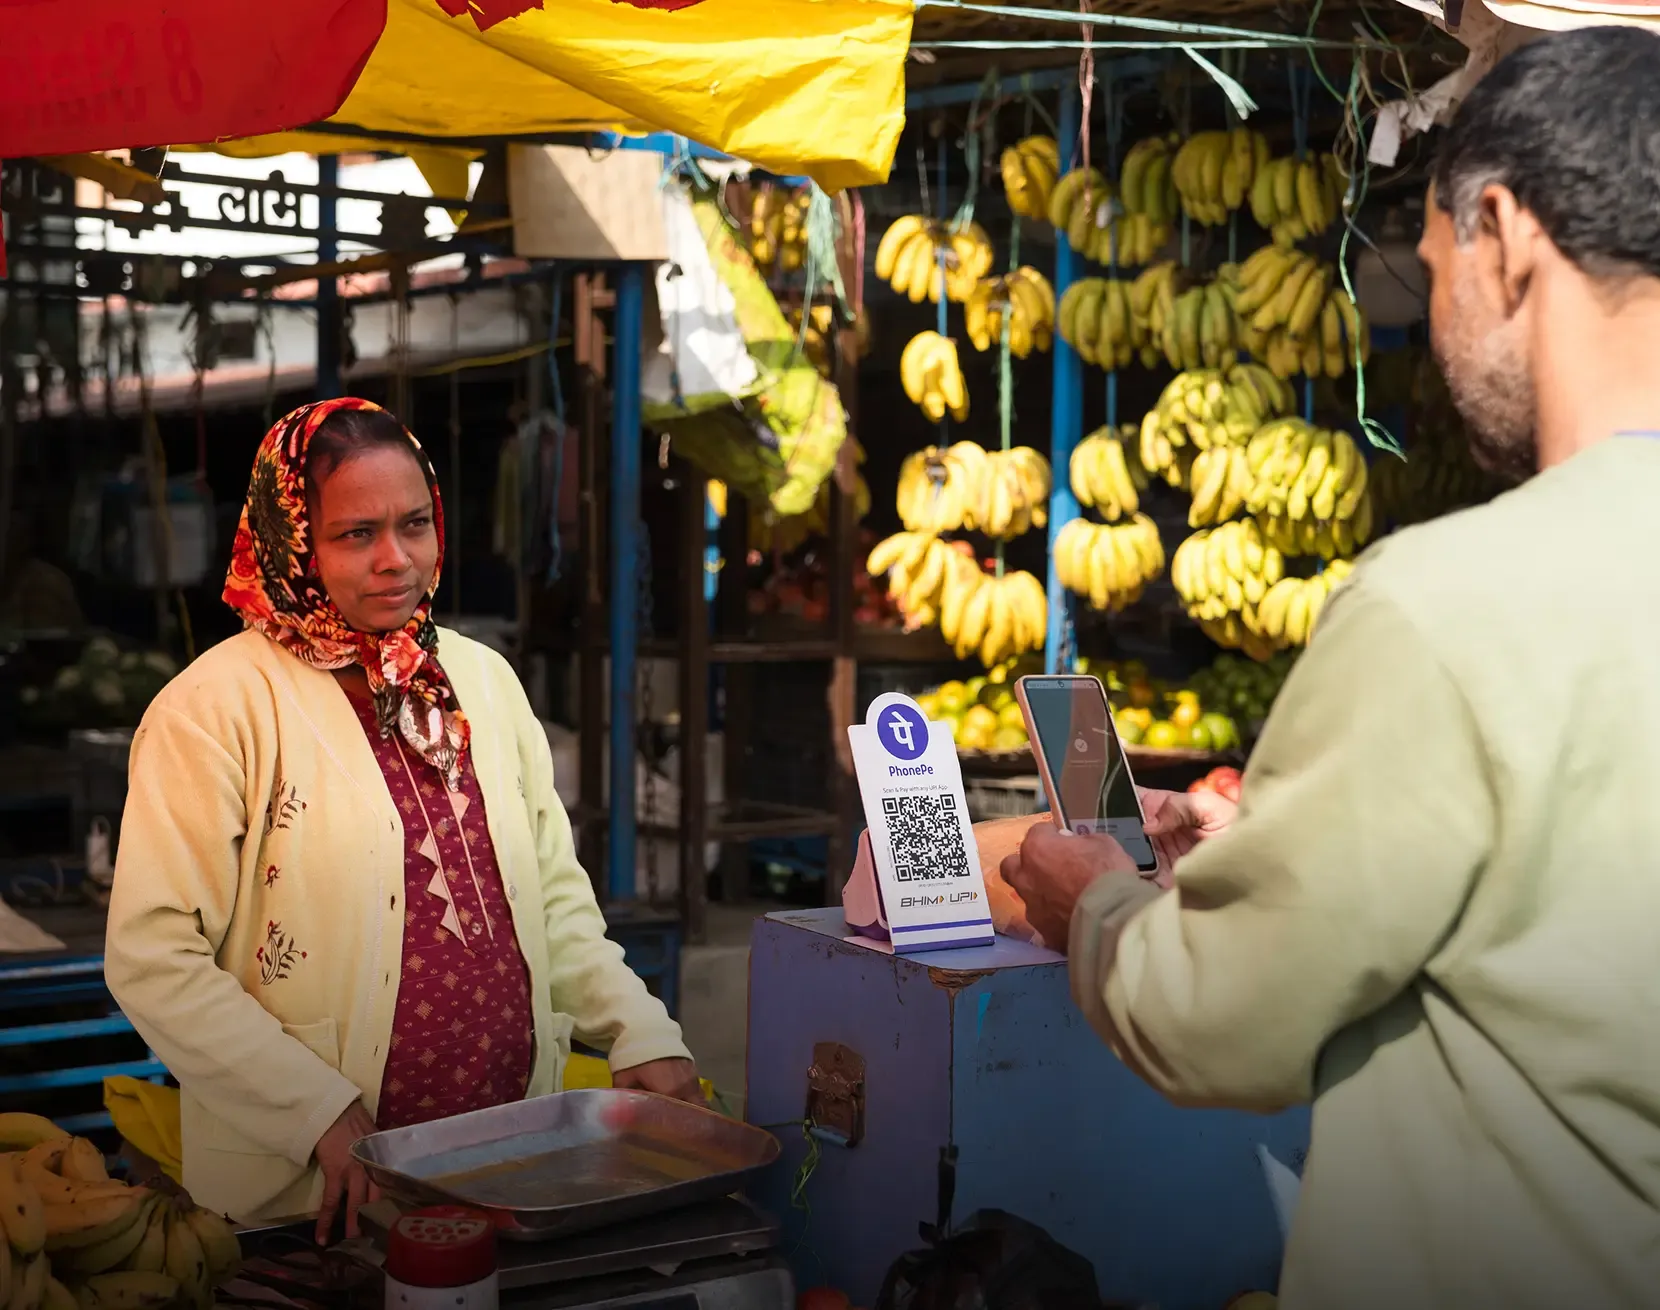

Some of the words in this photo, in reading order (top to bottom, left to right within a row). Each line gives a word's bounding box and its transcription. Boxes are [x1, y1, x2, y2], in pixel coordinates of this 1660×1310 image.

[888, 711, 915, 751] पे
[888, 764, 934, 777] PhonePe
[900, 896, 938, 907] BHIM
[949, 891, 973, 902] UPI
